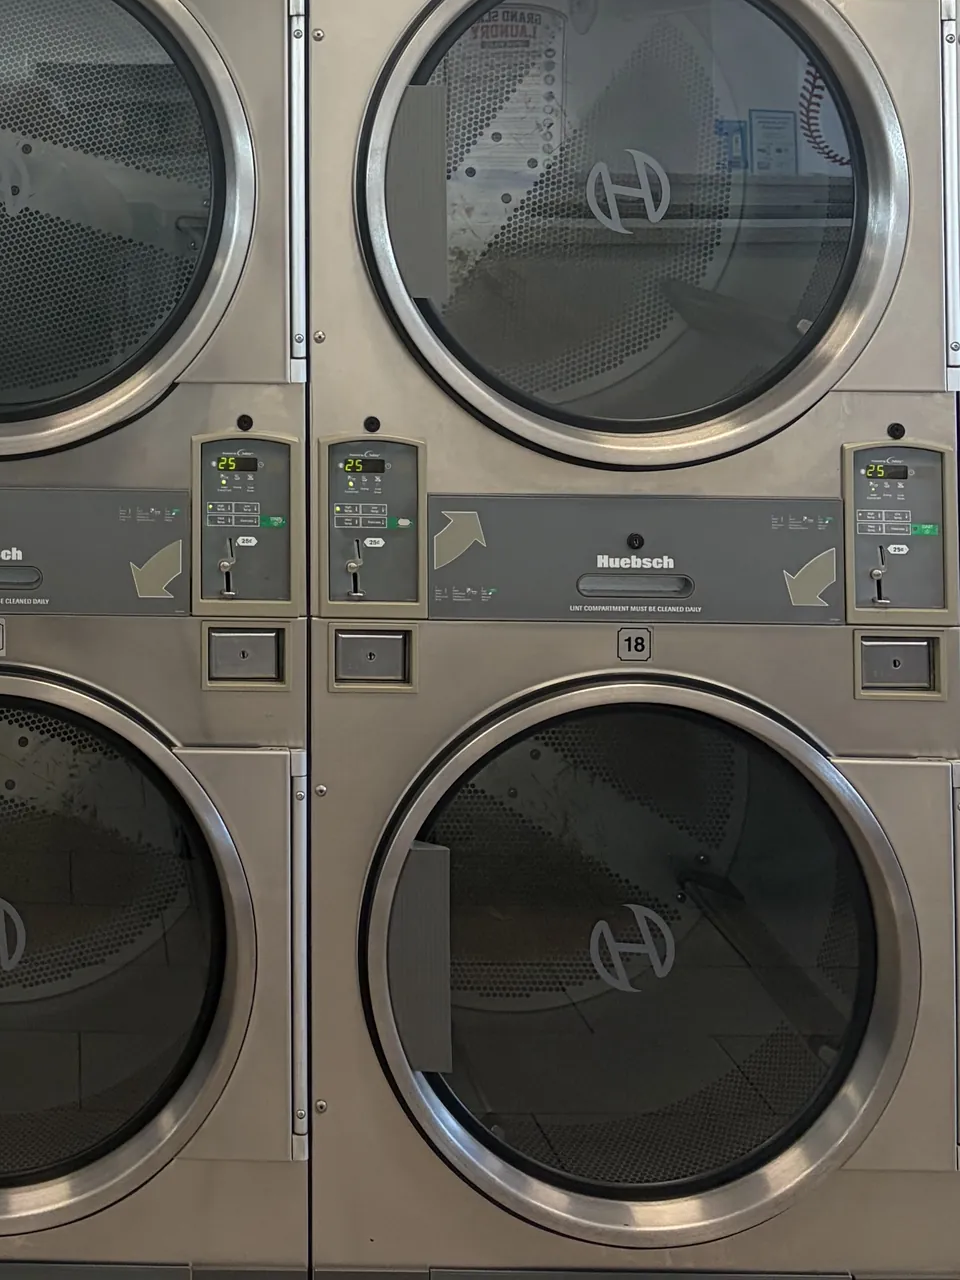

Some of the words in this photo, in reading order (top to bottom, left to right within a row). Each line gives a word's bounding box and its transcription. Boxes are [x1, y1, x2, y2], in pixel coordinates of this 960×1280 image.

[218, 457, 236, 470] 25
[345, 459, 363, 472] 25
[866, 464, 885, 477] 25
[596, 554, 675, 569] Huebsch
[624, 636, 646, 653] 18
